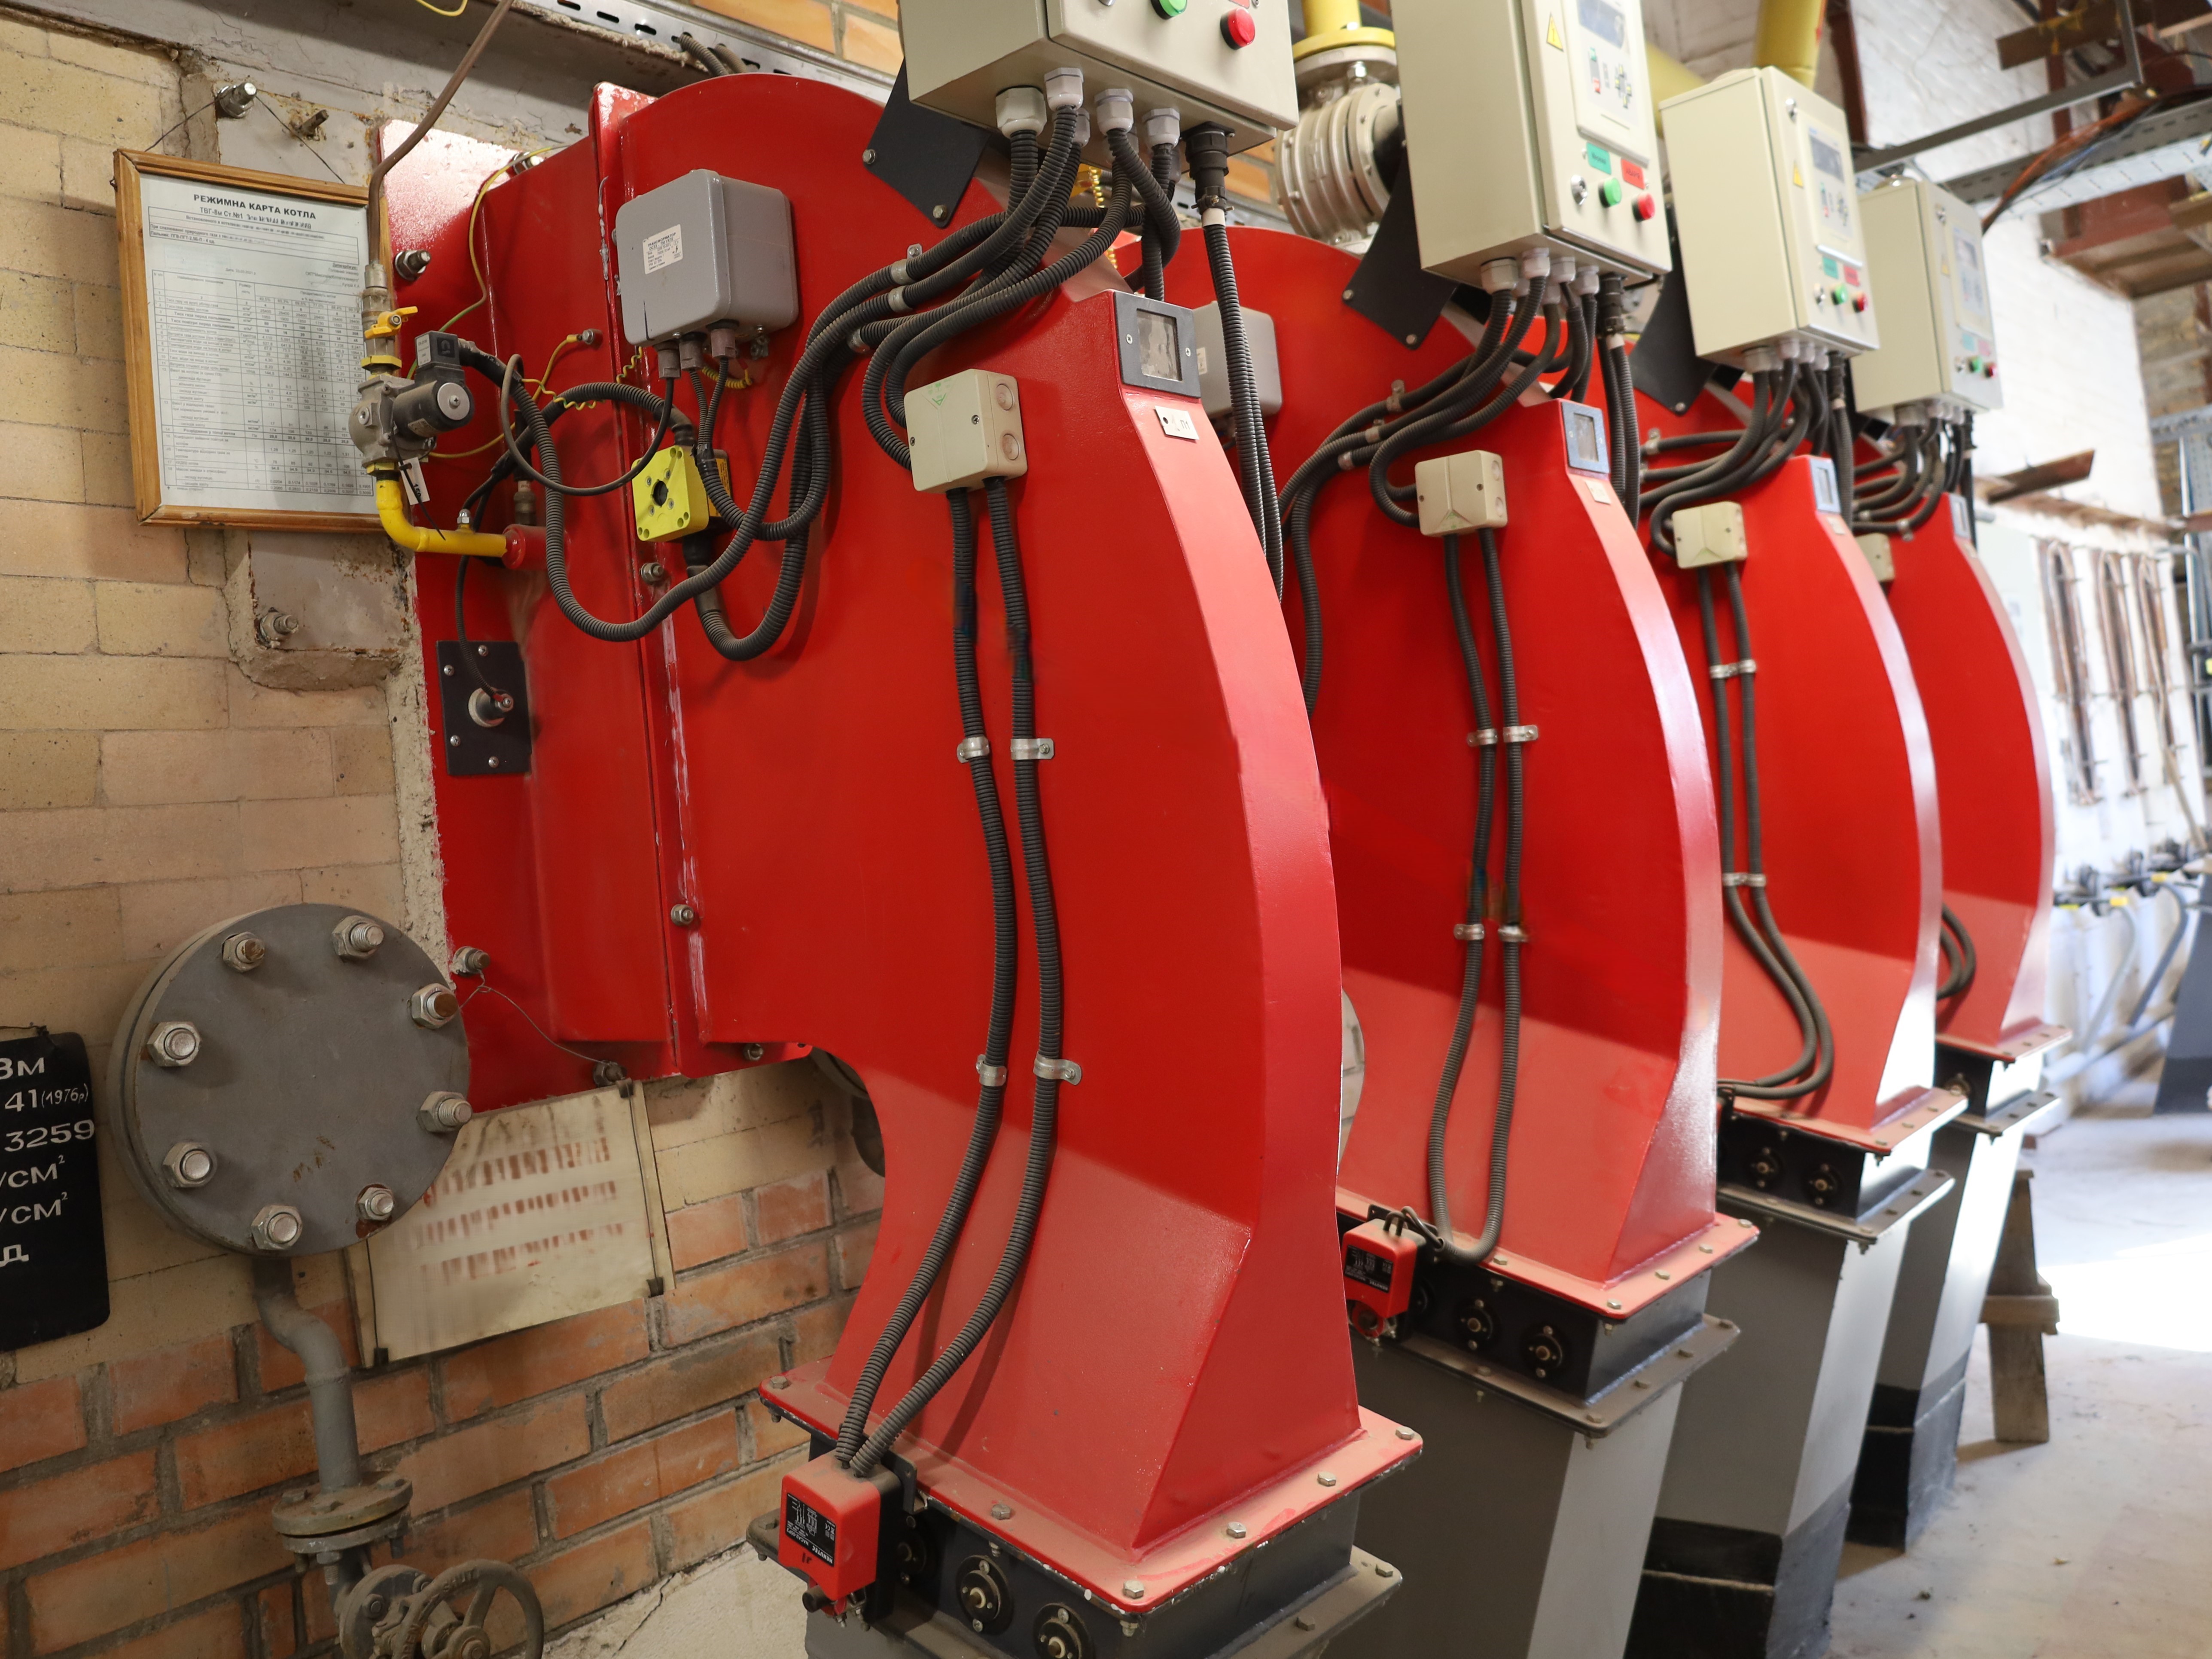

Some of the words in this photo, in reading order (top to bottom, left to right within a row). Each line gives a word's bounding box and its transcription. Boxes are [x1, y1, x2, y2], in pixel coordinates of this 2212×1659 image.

[193, 193, 246, 209] РЕЖИМНА
[249, 202, 280, 214] КАРТА
[284, 207, 316, 220] КОТЛА
[200, 207, 222, 216] ТВГ-8м
[223, 210, 243, 219] Ст.№1
[648, 232, 676, 247] ТРАНСФОРМАТОР
[4, 1119, 95, 1152] 3259
